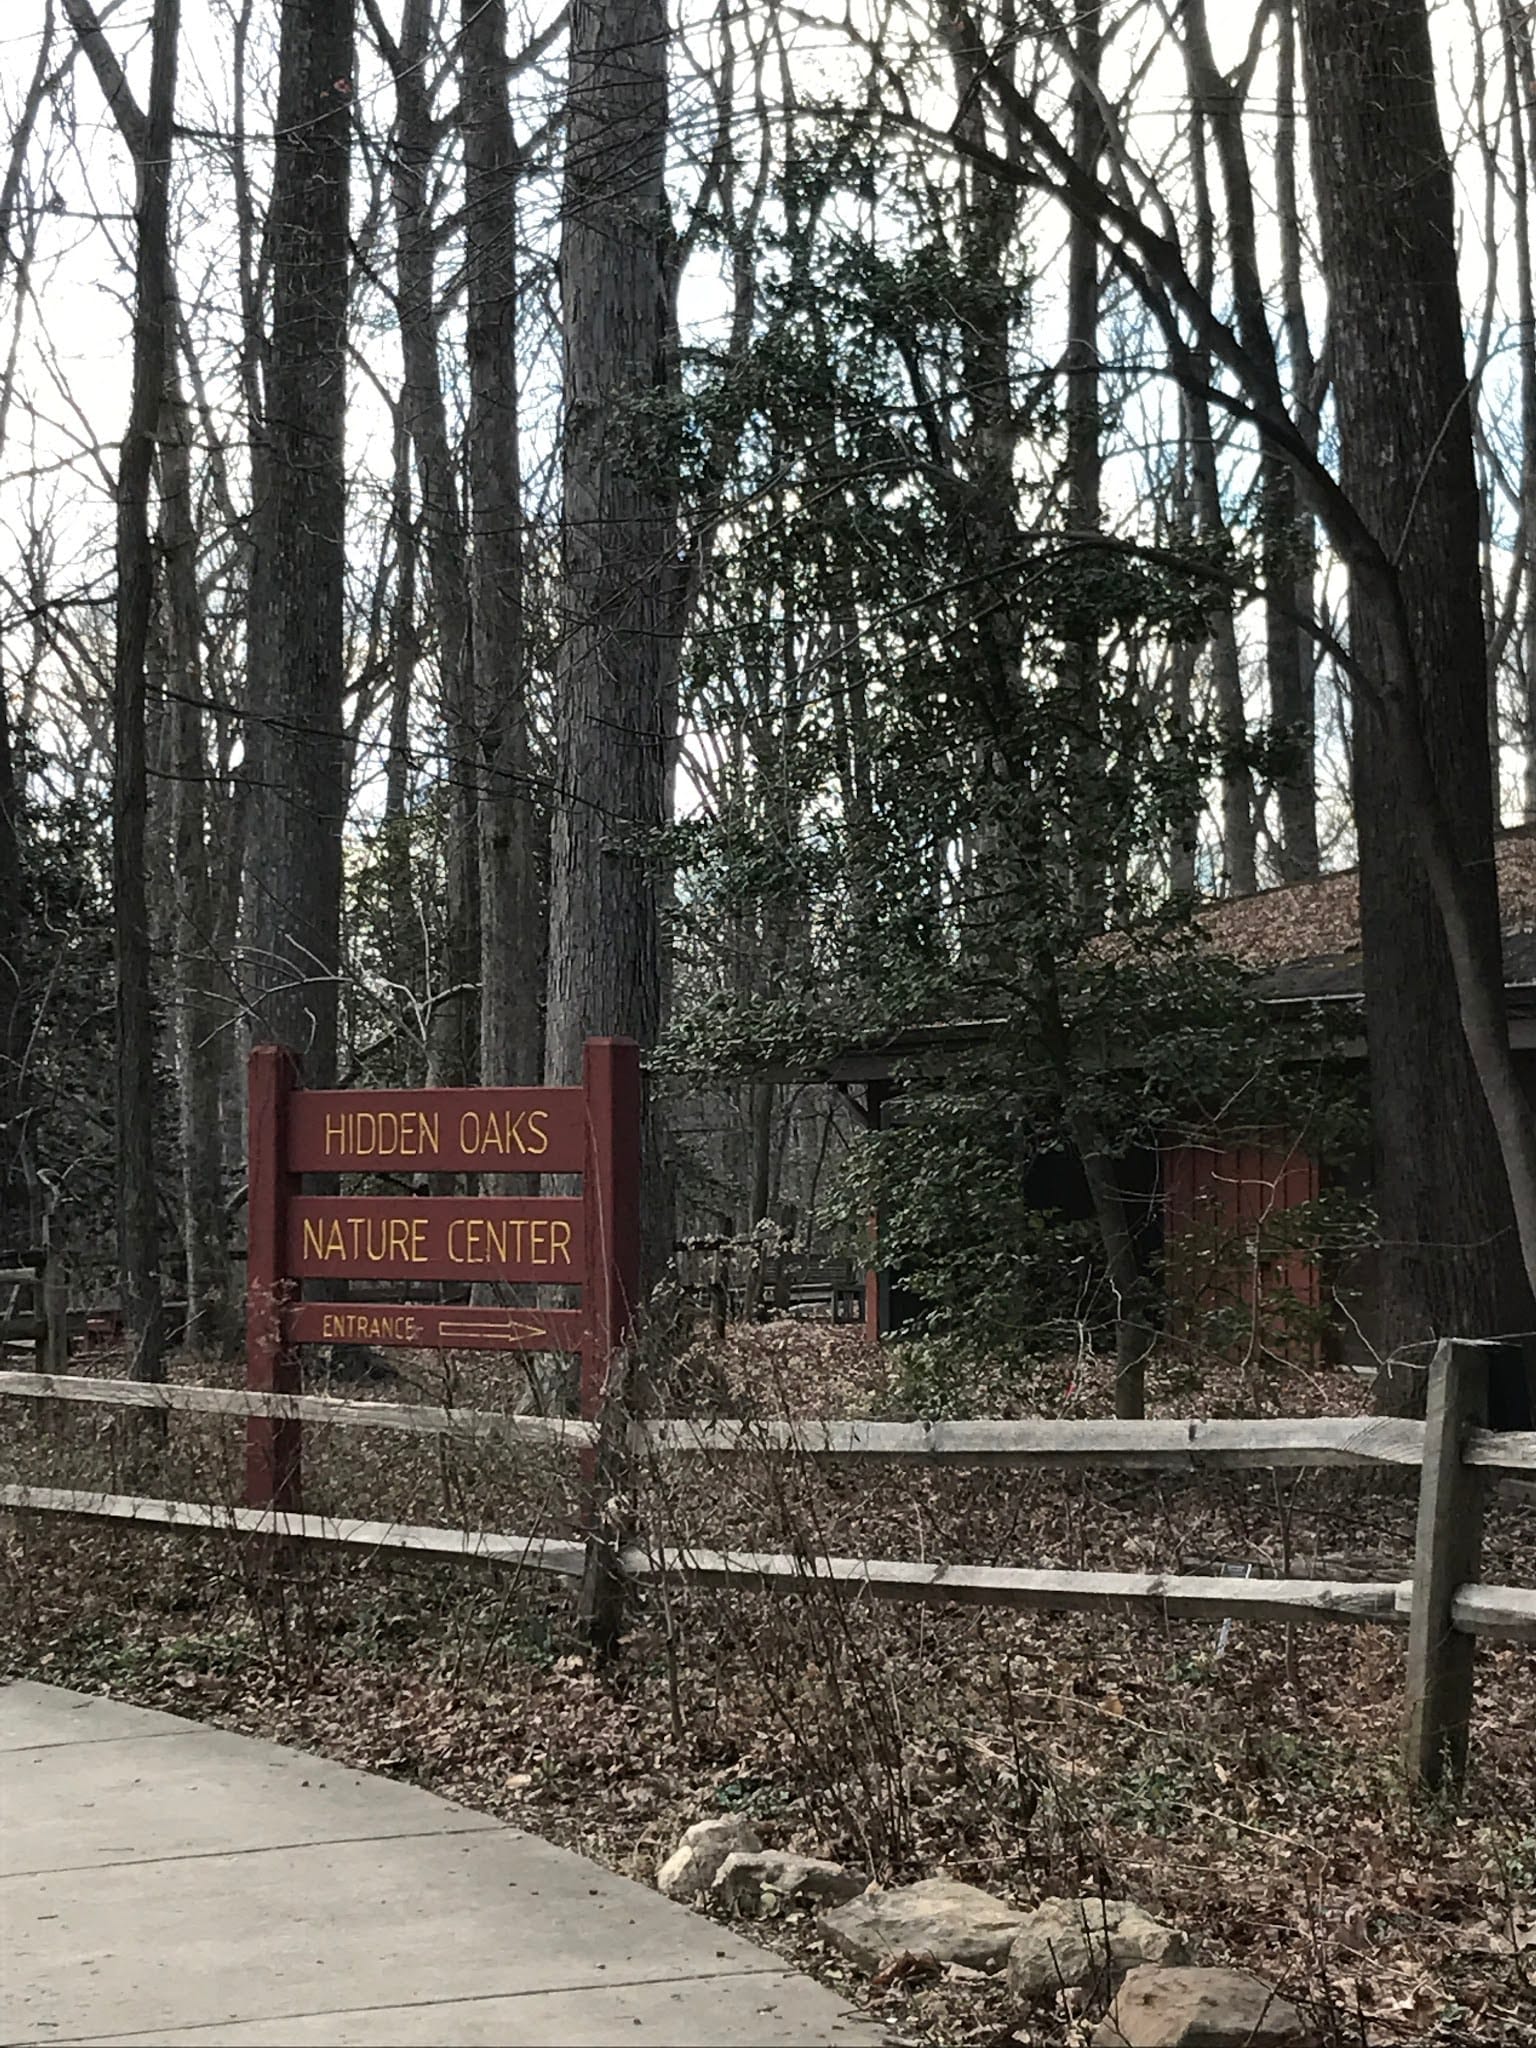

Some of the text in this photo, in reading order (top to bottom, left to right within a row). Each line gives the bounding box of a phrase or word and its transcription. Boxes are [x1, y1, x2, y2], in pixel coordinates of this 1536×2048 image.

[325, 1110, 550, 1156] HIDDEN OAKS
[302, 1217, 573, 1265] NATURE CENTER
[322, 1314, 416, 1340] ENTRANCE
